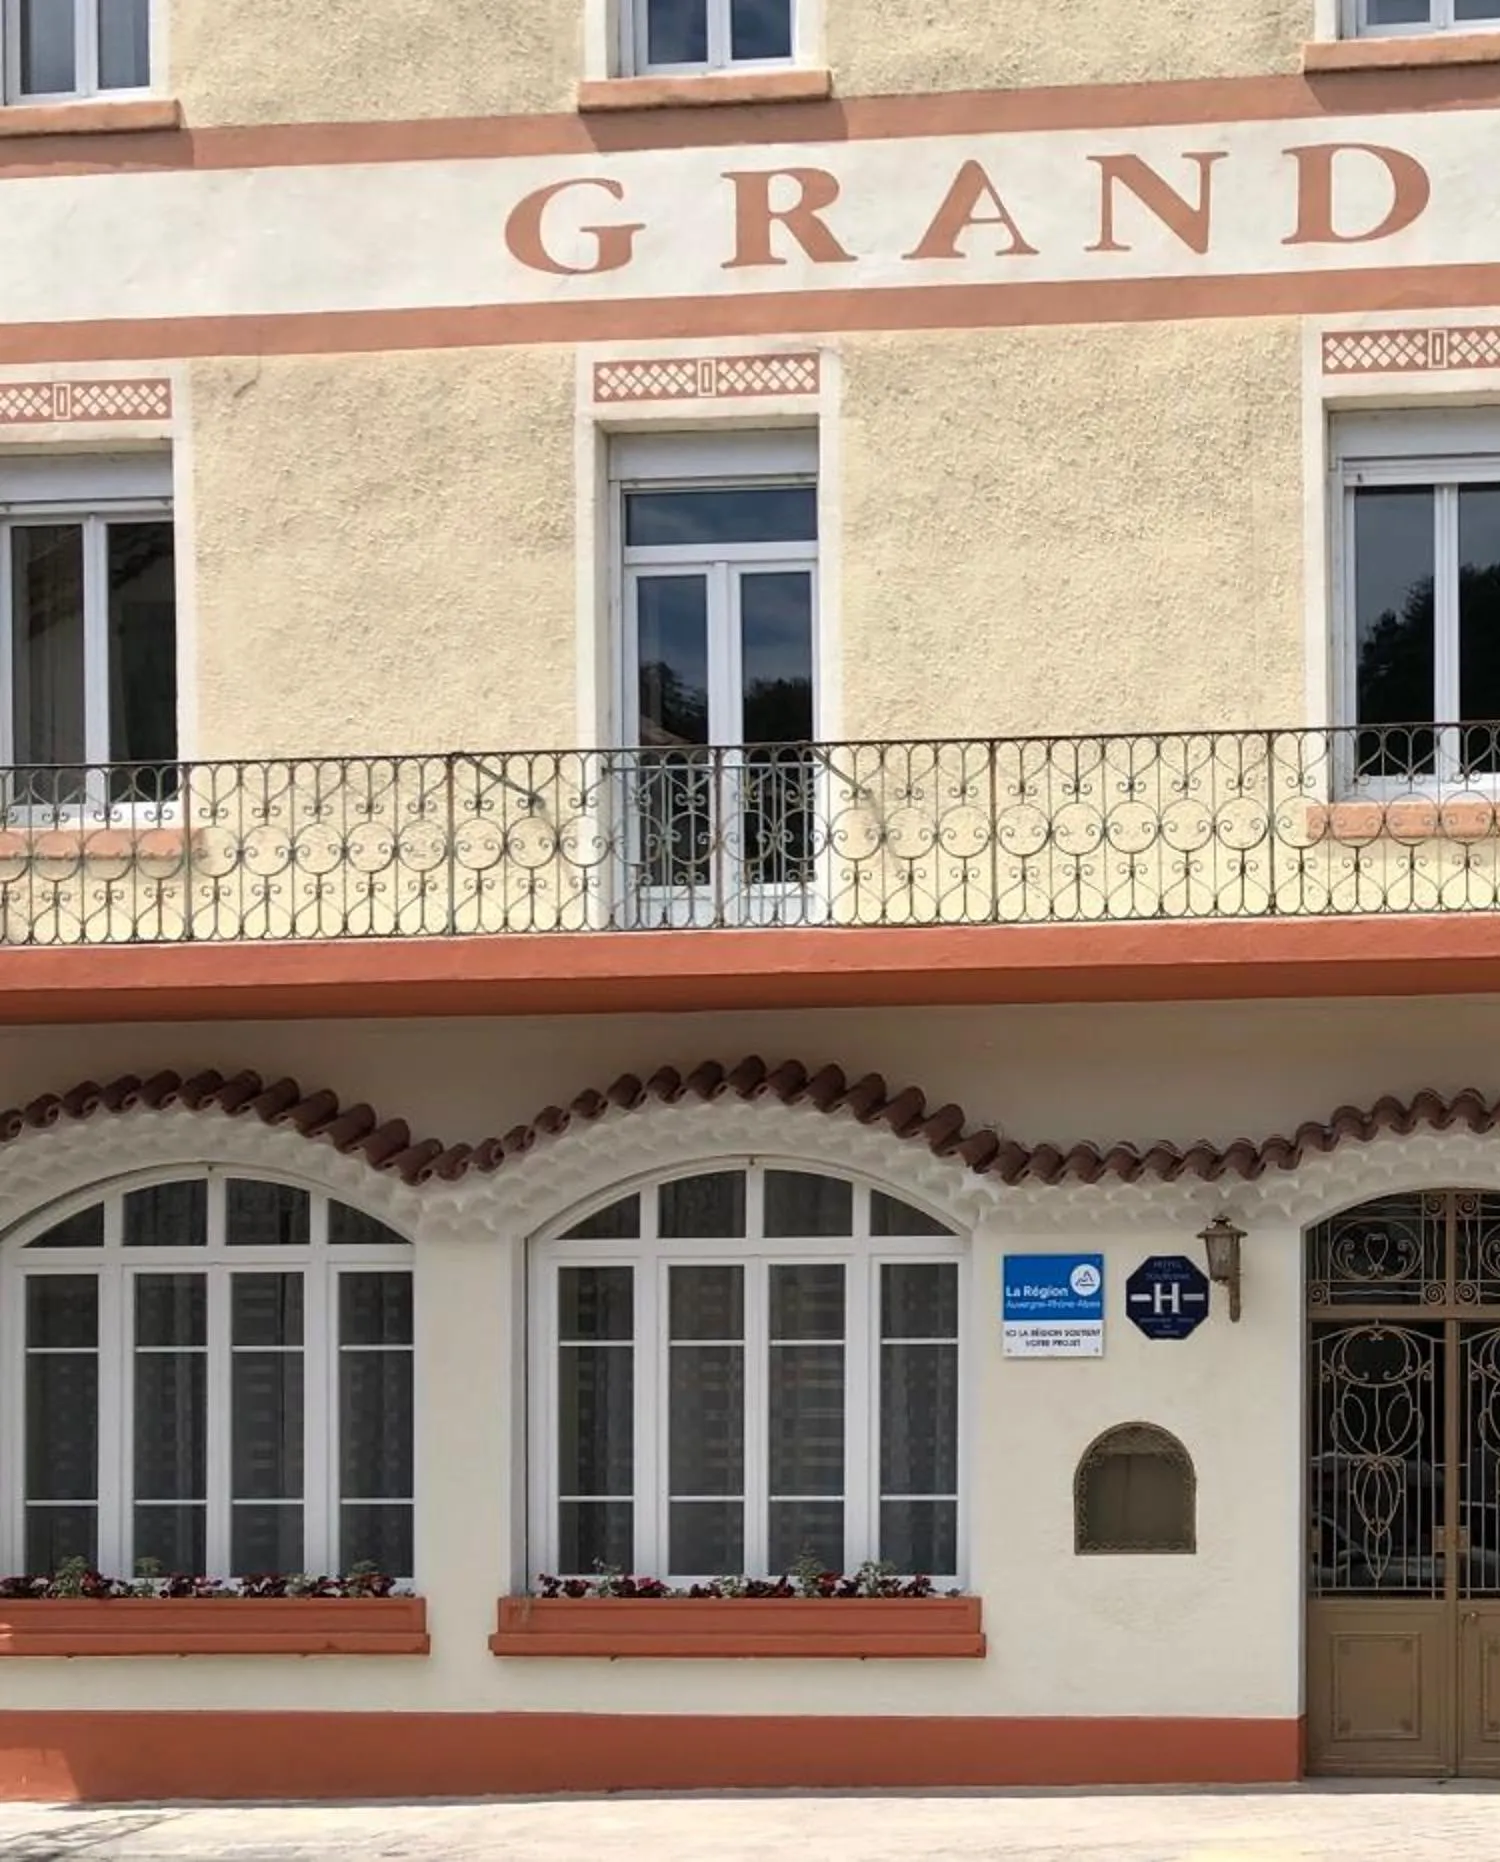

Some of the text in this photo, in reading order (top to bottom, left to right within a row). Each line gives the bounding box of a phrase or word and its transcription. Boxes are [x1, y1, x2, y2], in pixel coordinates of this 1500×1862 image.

[504, 142, 1431, 277] GRAND
[1006, 1286, 1069, 1299] La Région
[1153, 1282, 1181, 1315] H
